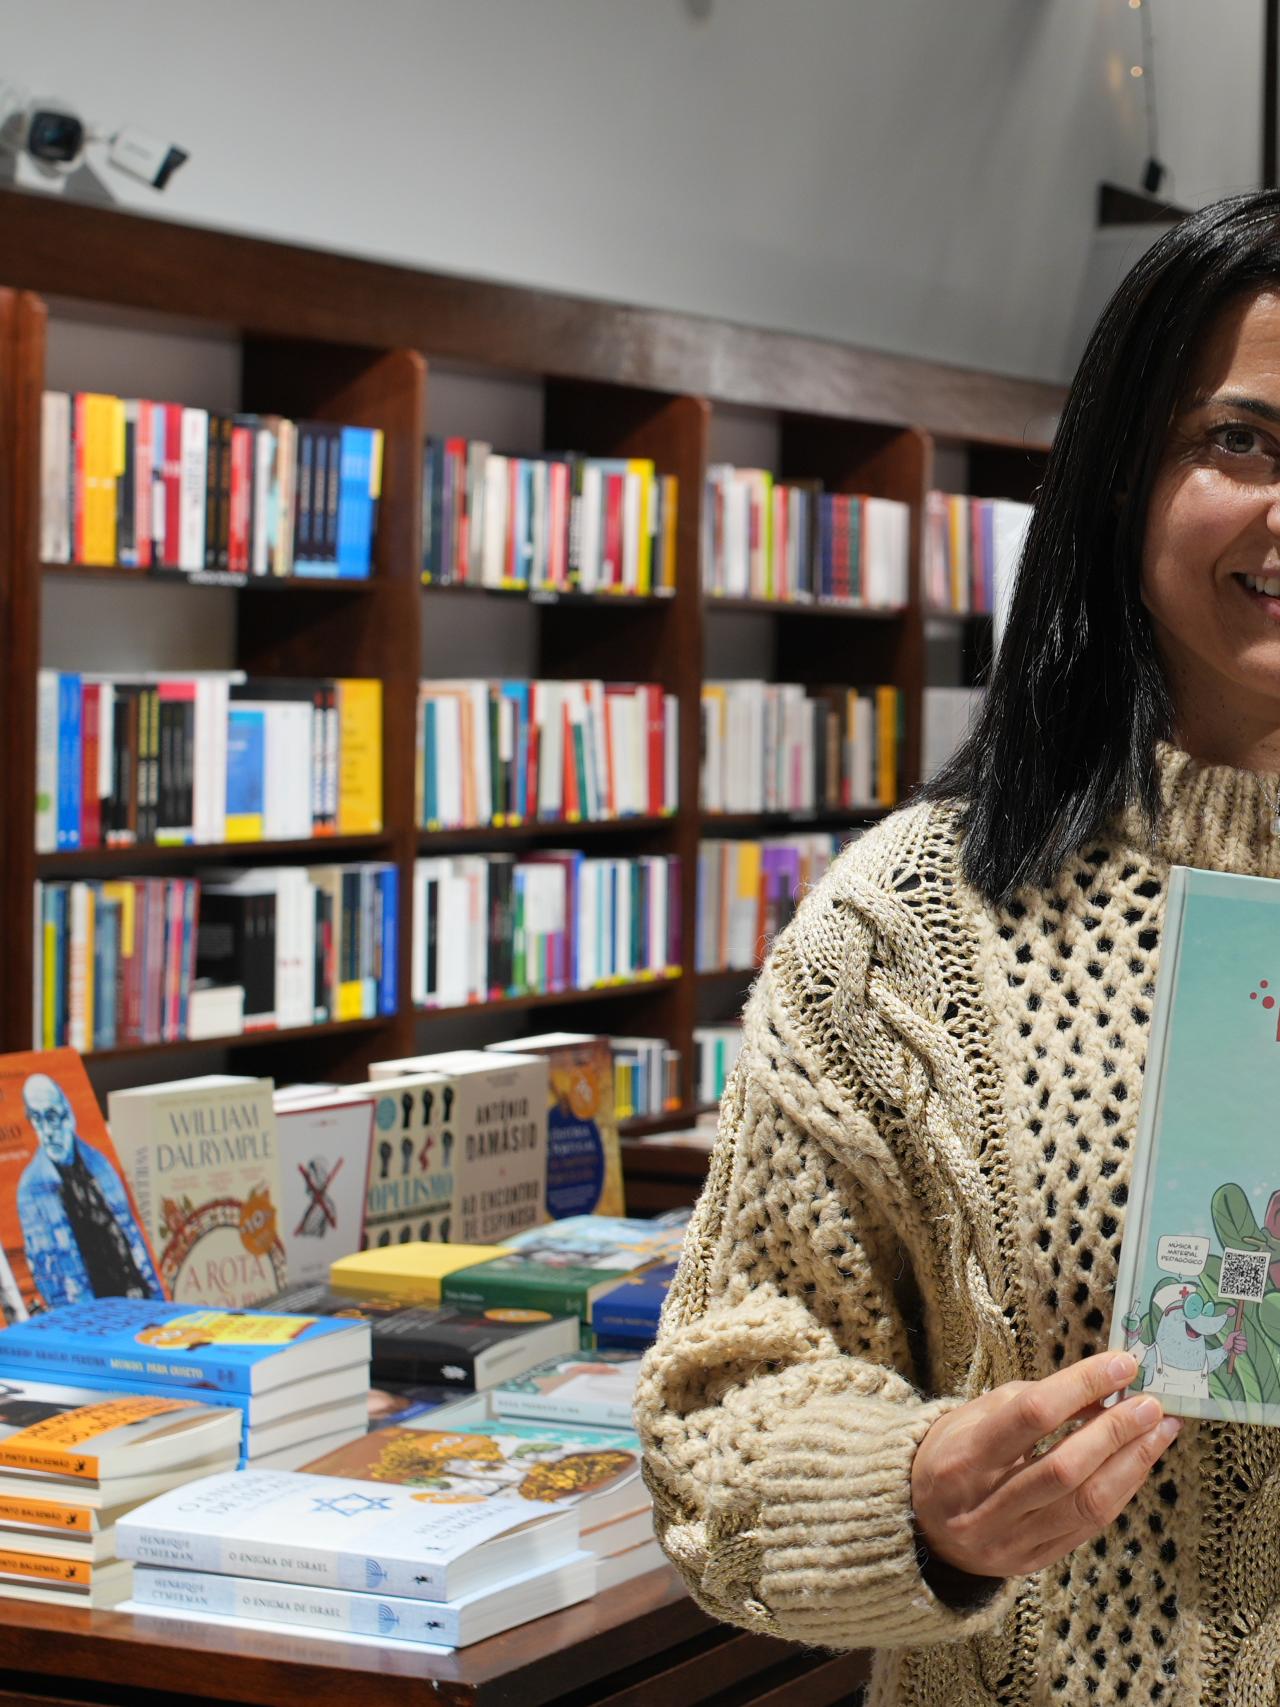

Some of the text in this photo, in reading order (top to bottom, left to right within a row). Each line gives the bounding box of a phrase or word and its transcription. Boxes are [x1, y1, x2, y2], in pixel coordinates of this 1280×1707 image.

[169, 1103, 260, 1137] WILLIAM
[157, 1131, 273, 1173] DALRYMPLE
[466, 1122, 538, 1163] DAMÁSIO
[368, 1170, 453, 1212] OPULISMO
[1161, 1255, 1203, 1265] PEDAGÓGICO
[183, 1255, 266, 1294] A ROTA
[140, 1534, 190, 1550] HENRIQUE
[137, 1546, 194, 1562] CYMERMAN
[229, 1553, 328, 1573] O ENIGMA DE ISRAEL
[154, 1578, 205, 1593] HENRIQUE
[152, 1589, 208, 1606] CYMERMAN
[243, 1596, 341, 1617] O ENIGMA DE ISRAEL
